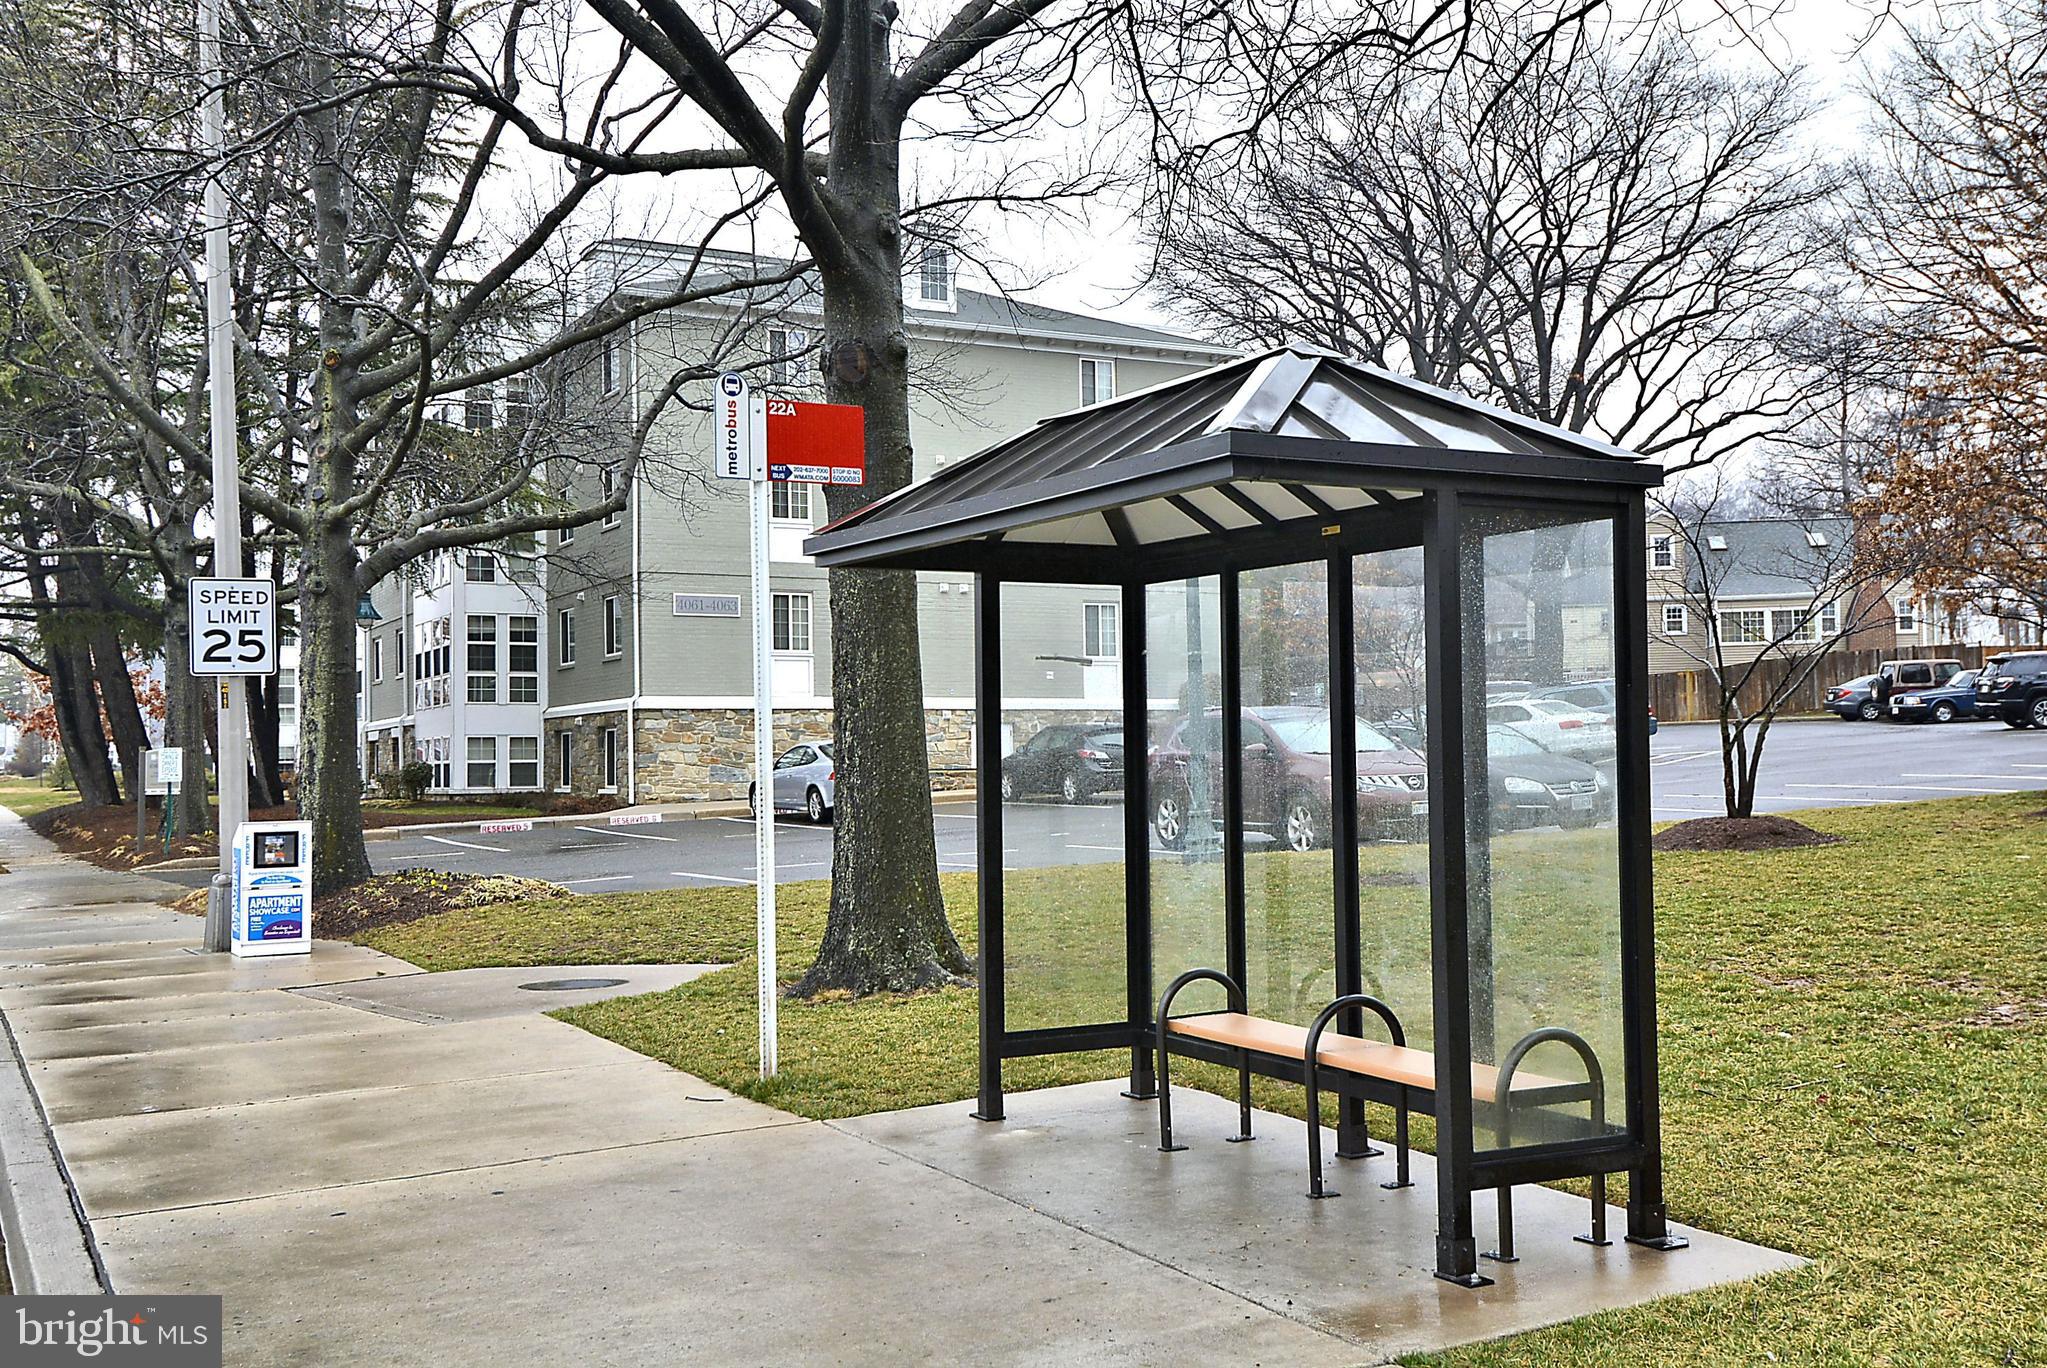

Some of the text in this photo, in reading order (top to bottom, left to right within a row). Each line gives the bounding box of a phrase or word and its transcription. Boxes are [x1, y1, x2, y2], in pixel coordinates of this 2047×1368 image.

[769, 402, 797, 417] 22A
[725, 400, 738, 475] metrobus
[771, 464, 786, 472] NEXT
[200, 589, 269, 605] SPEED
[677, 599, 738, 611] 4061-4063
[208, 609, 260, 624] LIMIT
[202, 629, 266, 663] 25
[611, 815, 649, 825] RESERVED
[481, 824, 522, 833] RESERVED
[250, 896, 302, 908] APARTMENT
[249, 906, 290, 916] SHOWCASE
